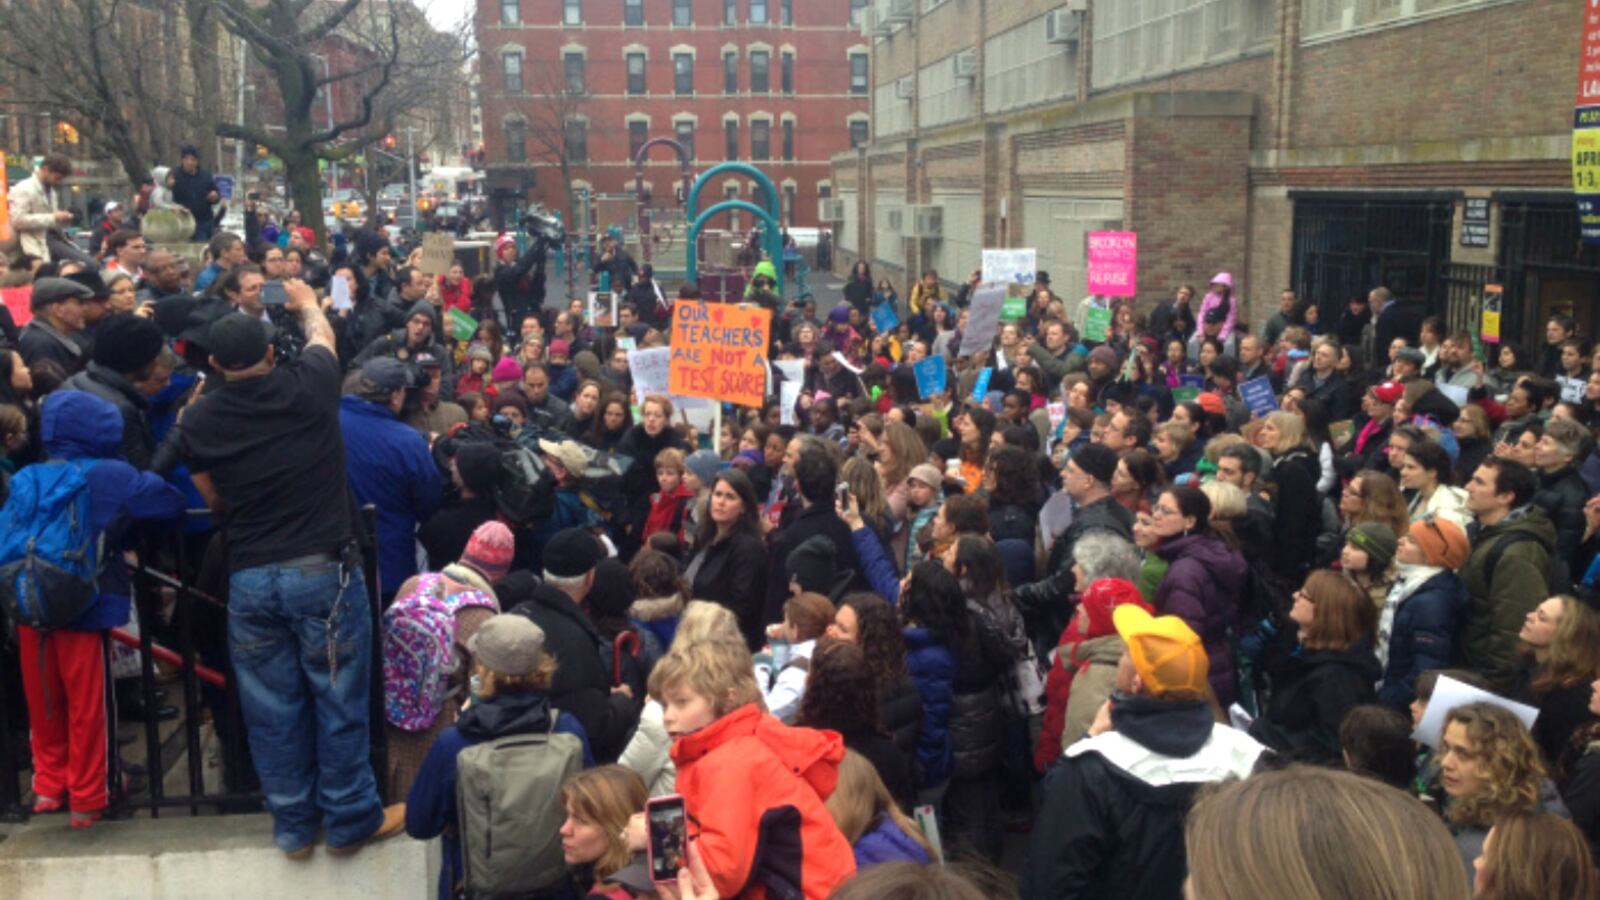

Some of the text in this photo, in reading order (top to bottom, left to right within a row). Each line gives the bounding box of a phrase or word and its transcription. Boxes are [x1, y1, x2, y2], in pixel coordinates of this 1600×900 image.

[1089, 236, 1136, 249] BROOKLYN
[1089, 271, 1128, 286] REFUSE
[678, 304, 709, 321] OUR
[678, 323, 763, 348] TEACHERS
[673, 347, 764, 368] ARE NOT A
[677, 365, 718, 394] TEST
[719, 369, 764, 397] SCORE
